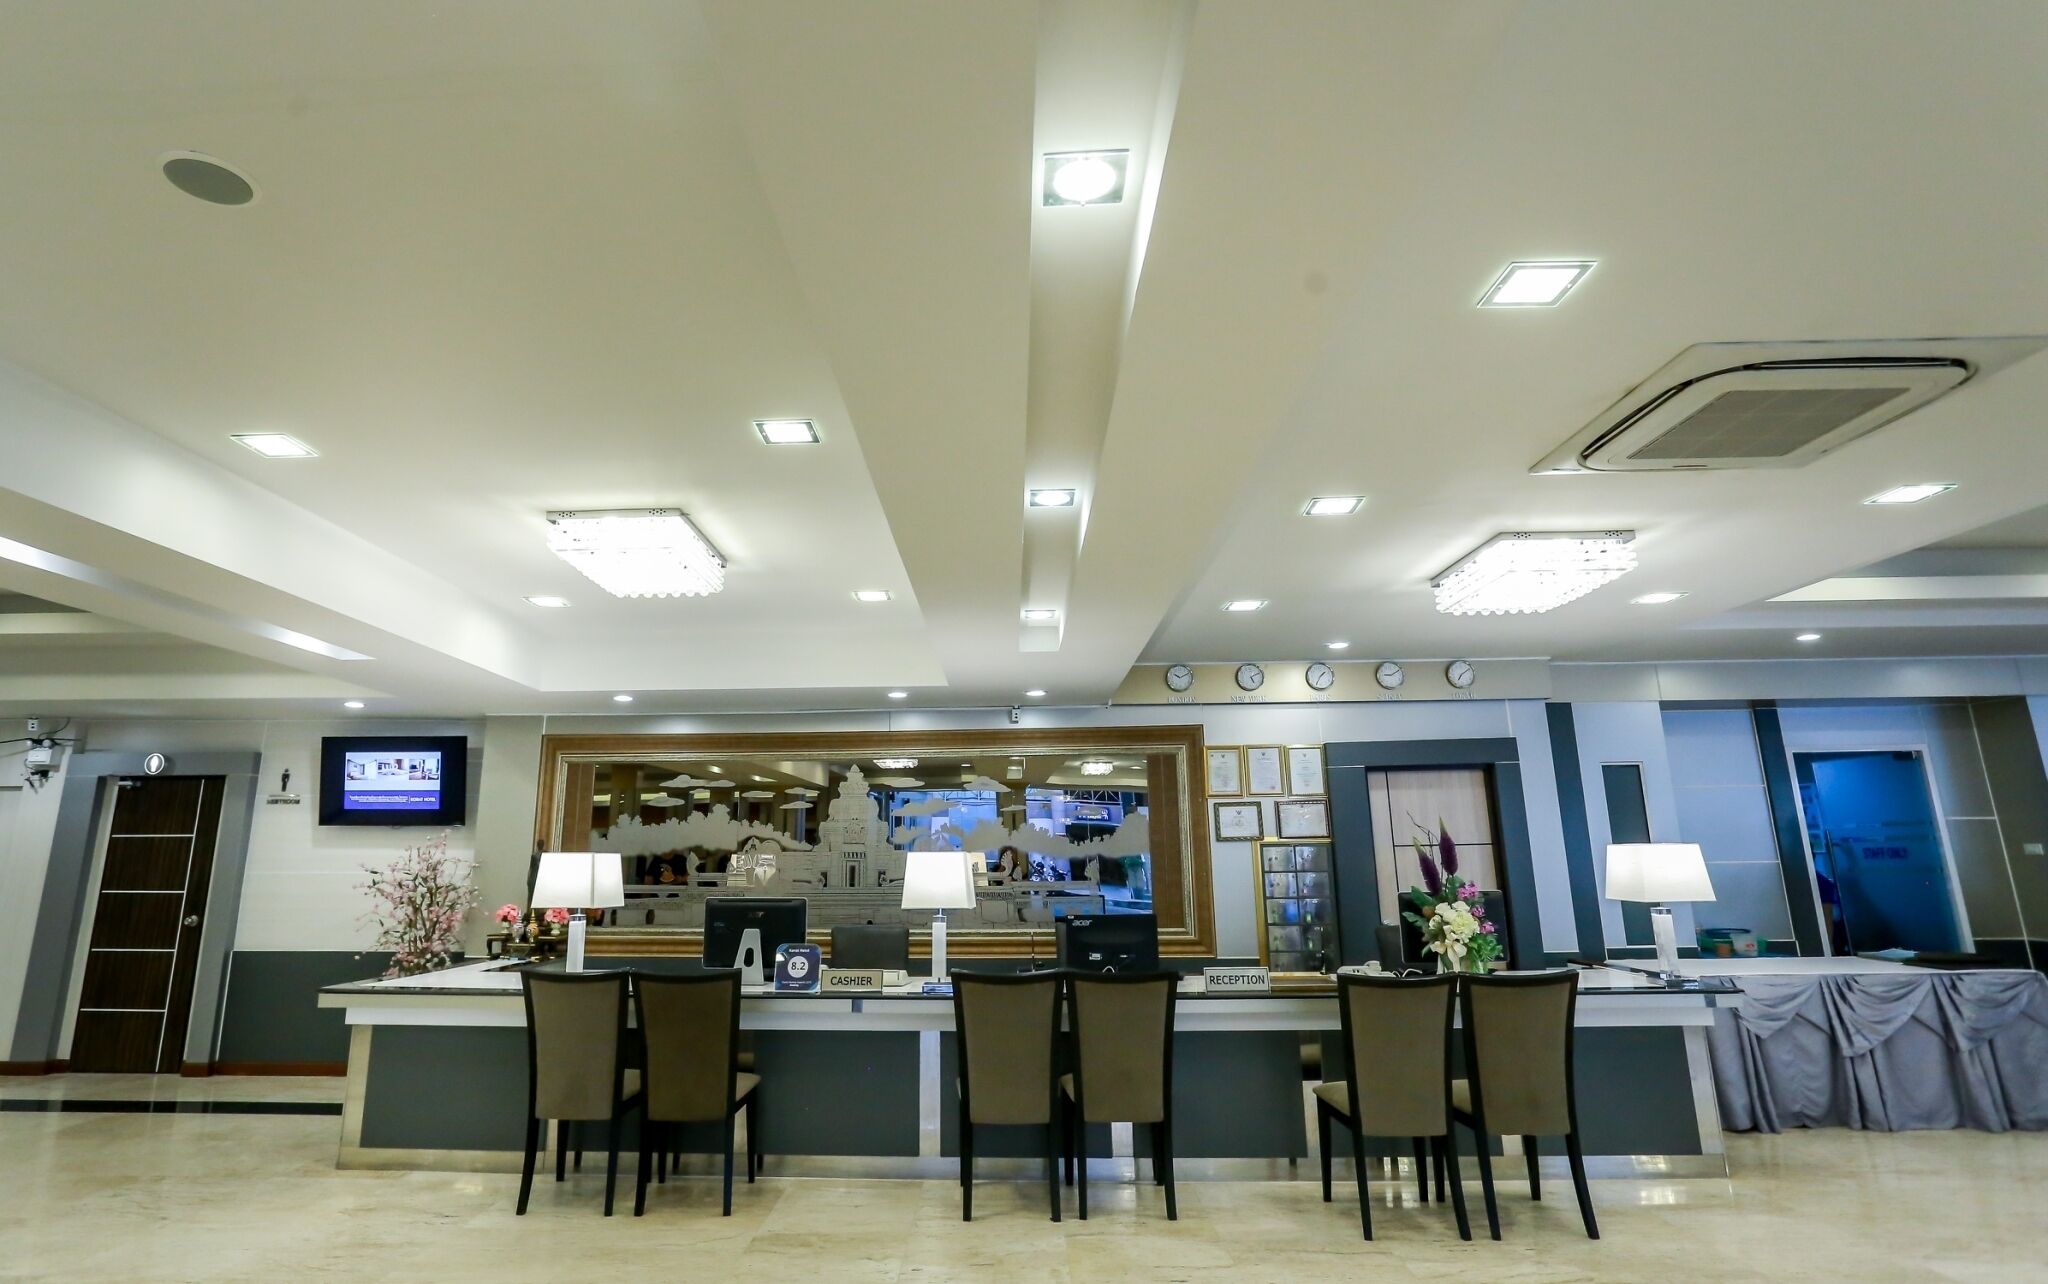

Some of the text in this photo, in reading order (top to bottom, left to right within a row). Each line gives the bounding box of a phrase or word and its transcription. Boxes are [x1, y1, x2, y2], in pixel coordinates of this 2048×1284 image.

[791, 961, 806, 970] 8.2
[830, 976, 873, 986] CASHIER
[1209, 975, 1265, 985] RECEPTION
